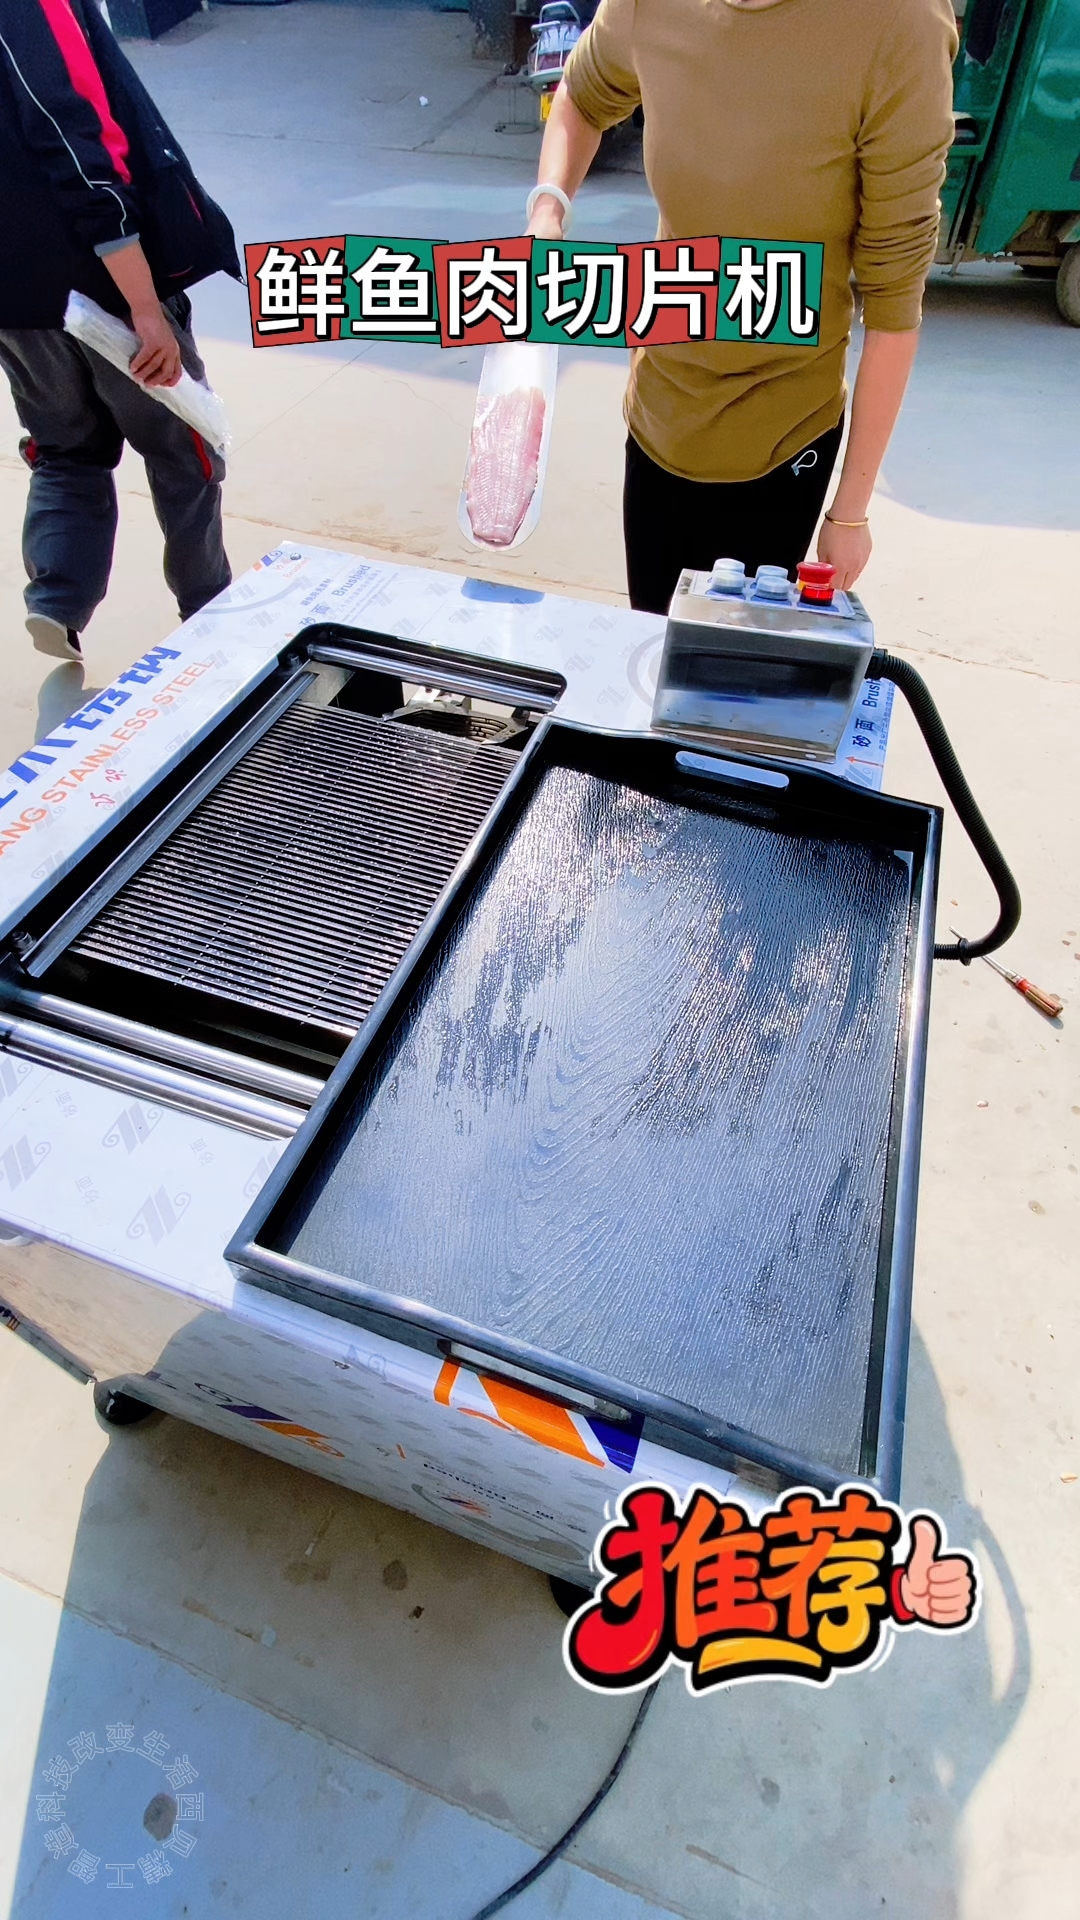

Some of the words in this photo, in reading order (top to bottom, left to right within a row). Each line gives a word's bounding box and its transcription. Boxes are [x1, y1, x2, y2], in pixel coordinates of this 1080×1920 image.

[331, 564, 371, 597] Brushed
[41, 707, 159, 803] STAINLESS
[152, 660, 214, 706] STEEL
